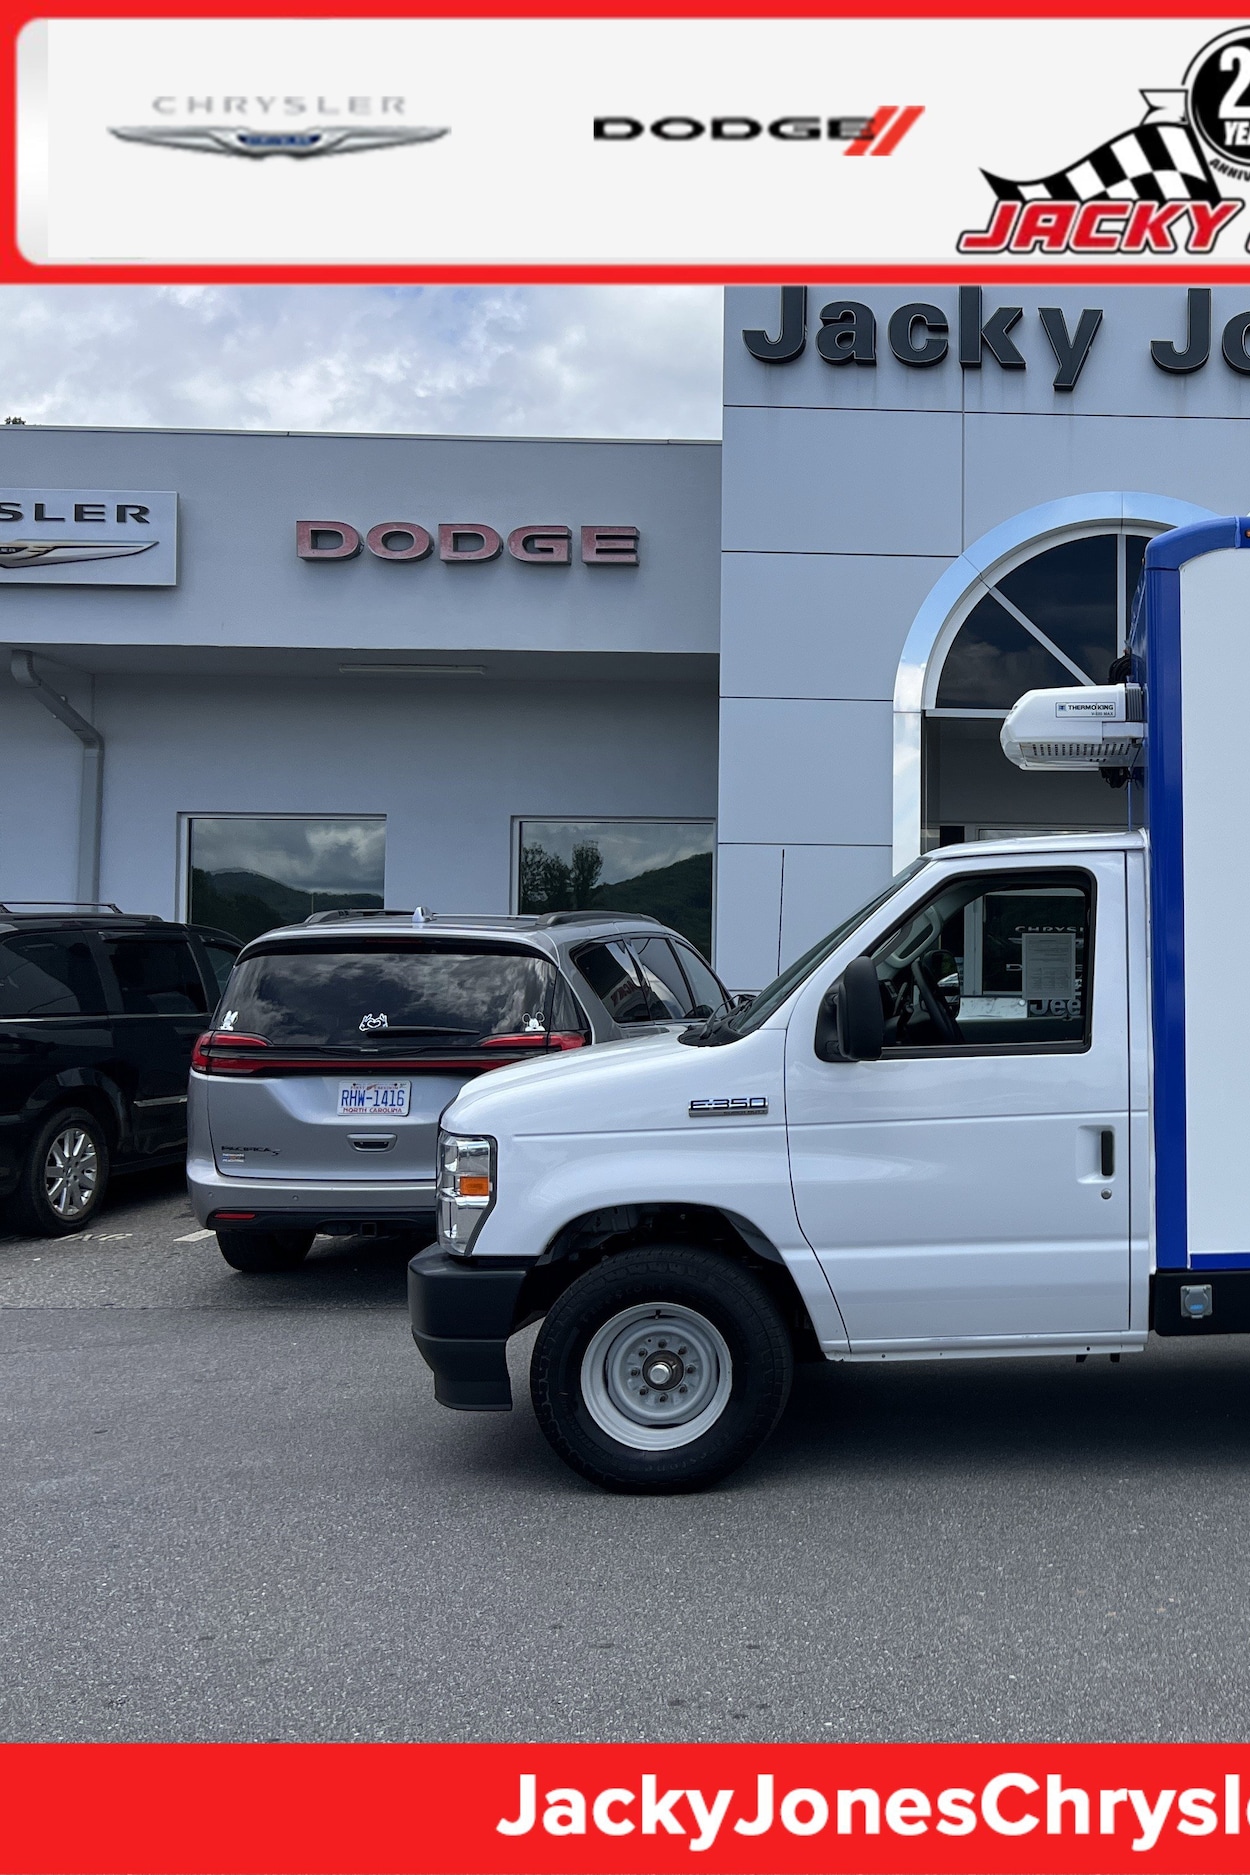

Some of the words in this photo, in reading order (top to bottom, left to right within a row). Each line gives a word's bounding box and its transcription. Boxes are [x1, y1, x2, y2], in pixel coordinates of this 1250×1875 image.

[742, 286, 1103, 391] Jacky
[296, 520, 641, 567] DODGE
[341, 1089, 405, 1107] RHW-1416
